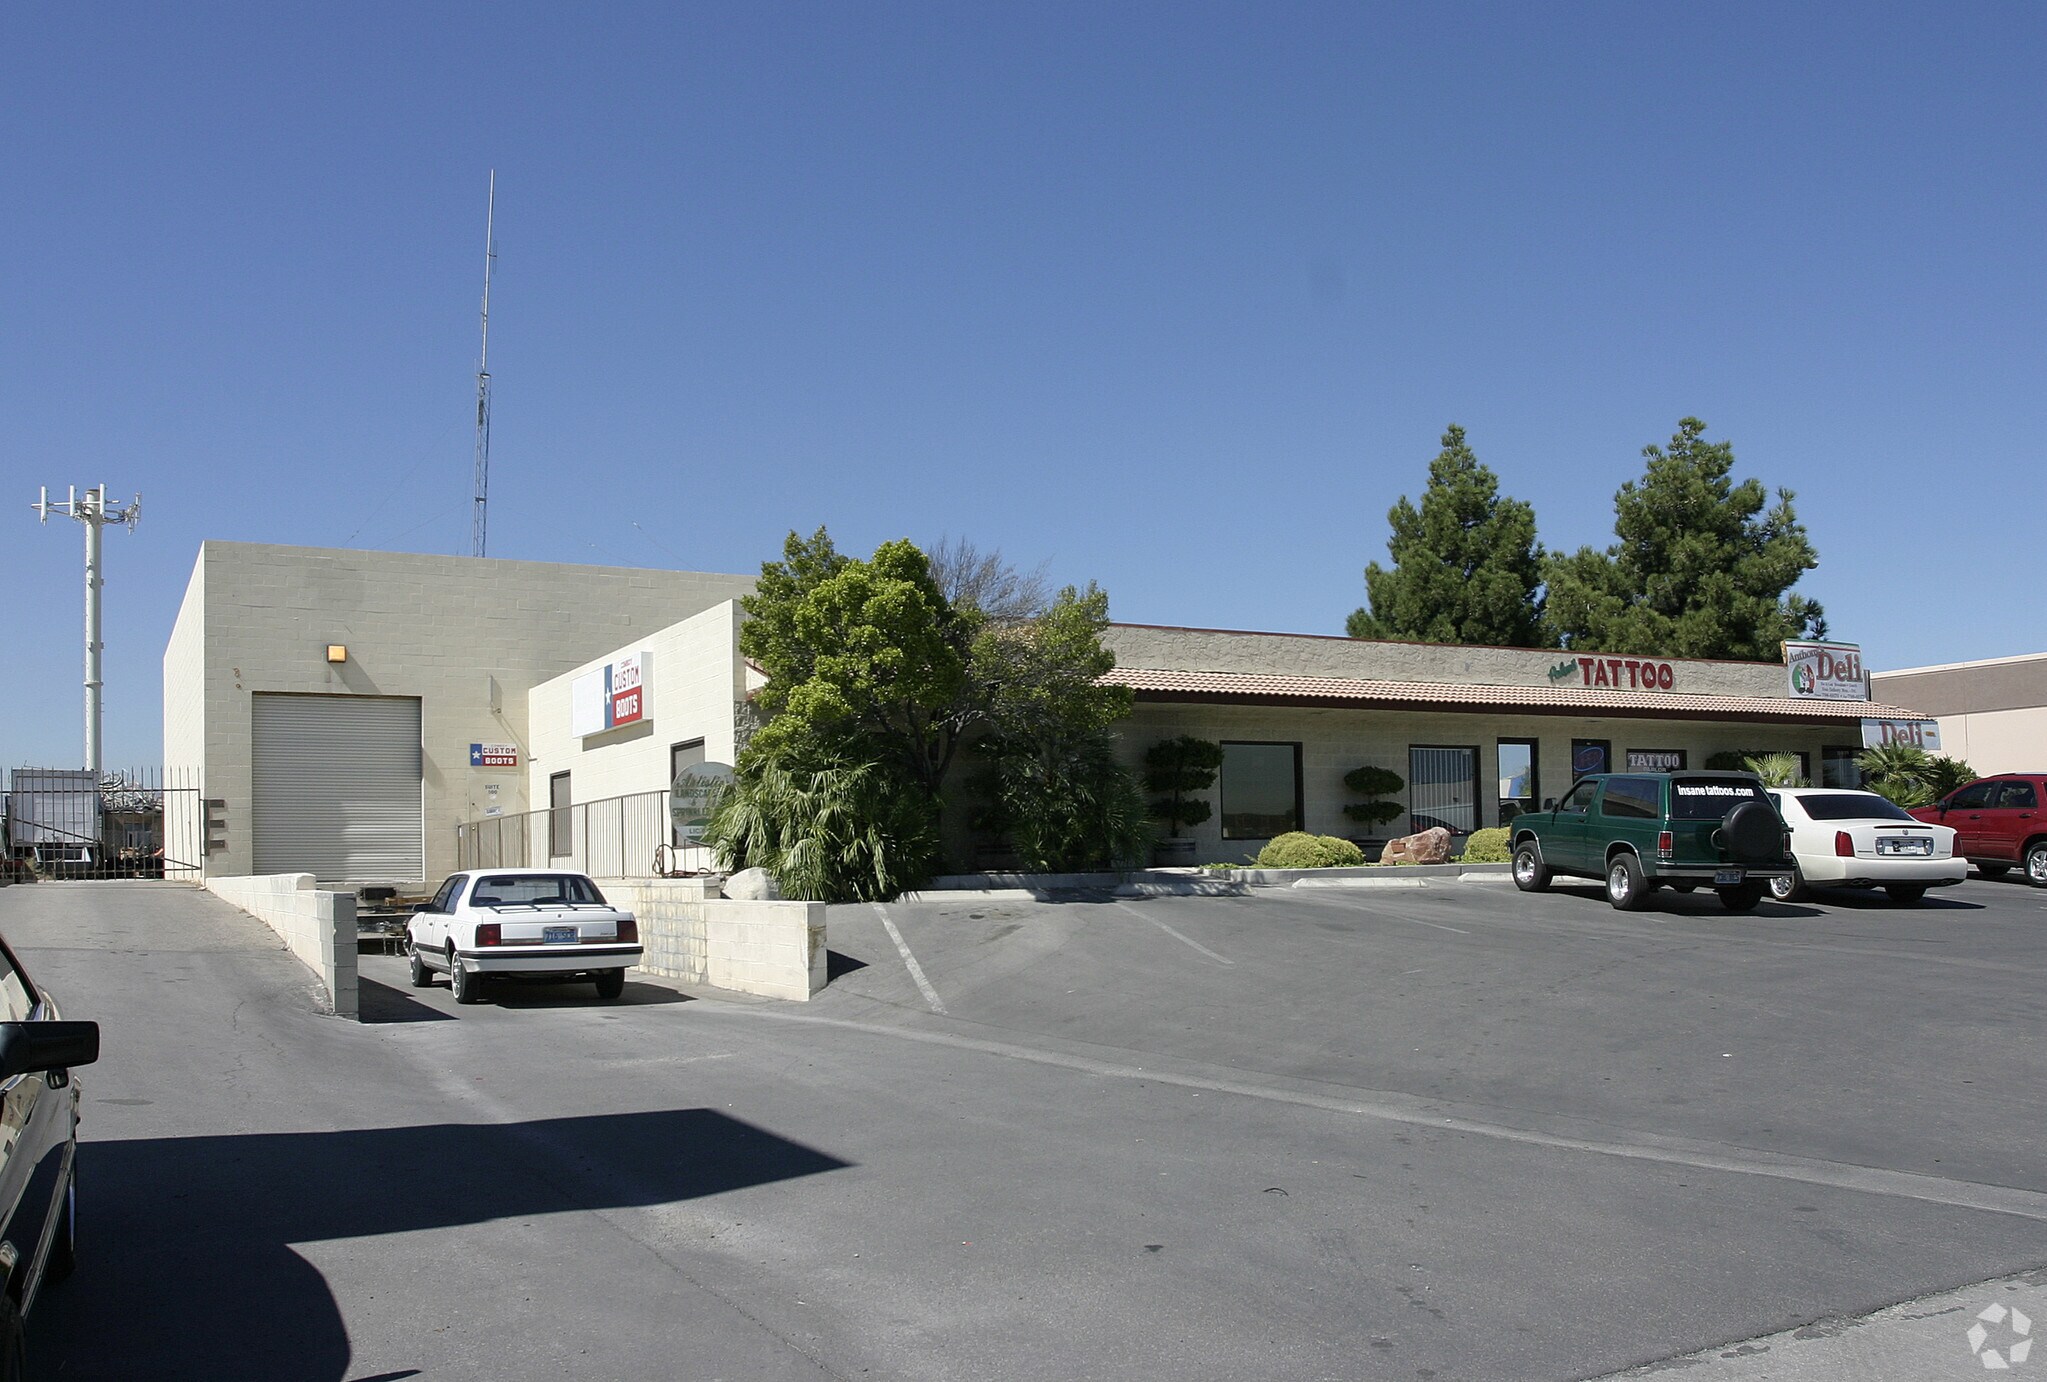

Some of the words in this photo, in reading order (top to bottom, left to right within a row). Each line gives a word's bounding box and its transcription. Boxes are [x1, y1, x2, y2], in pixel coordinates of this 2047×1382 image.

[615, 665, 639, 691] CUSTOM
[1578, 658, 1673, 690] TATTOO
[1816, 651, 1863, 682] Deli
[616, 694, 638, 719] BOOTS
[1629, 754, 1680, 767] TATTOO
[1677, 784, 1706, 796] insane
[1705, 785, 1754, 797] tattoos.com
